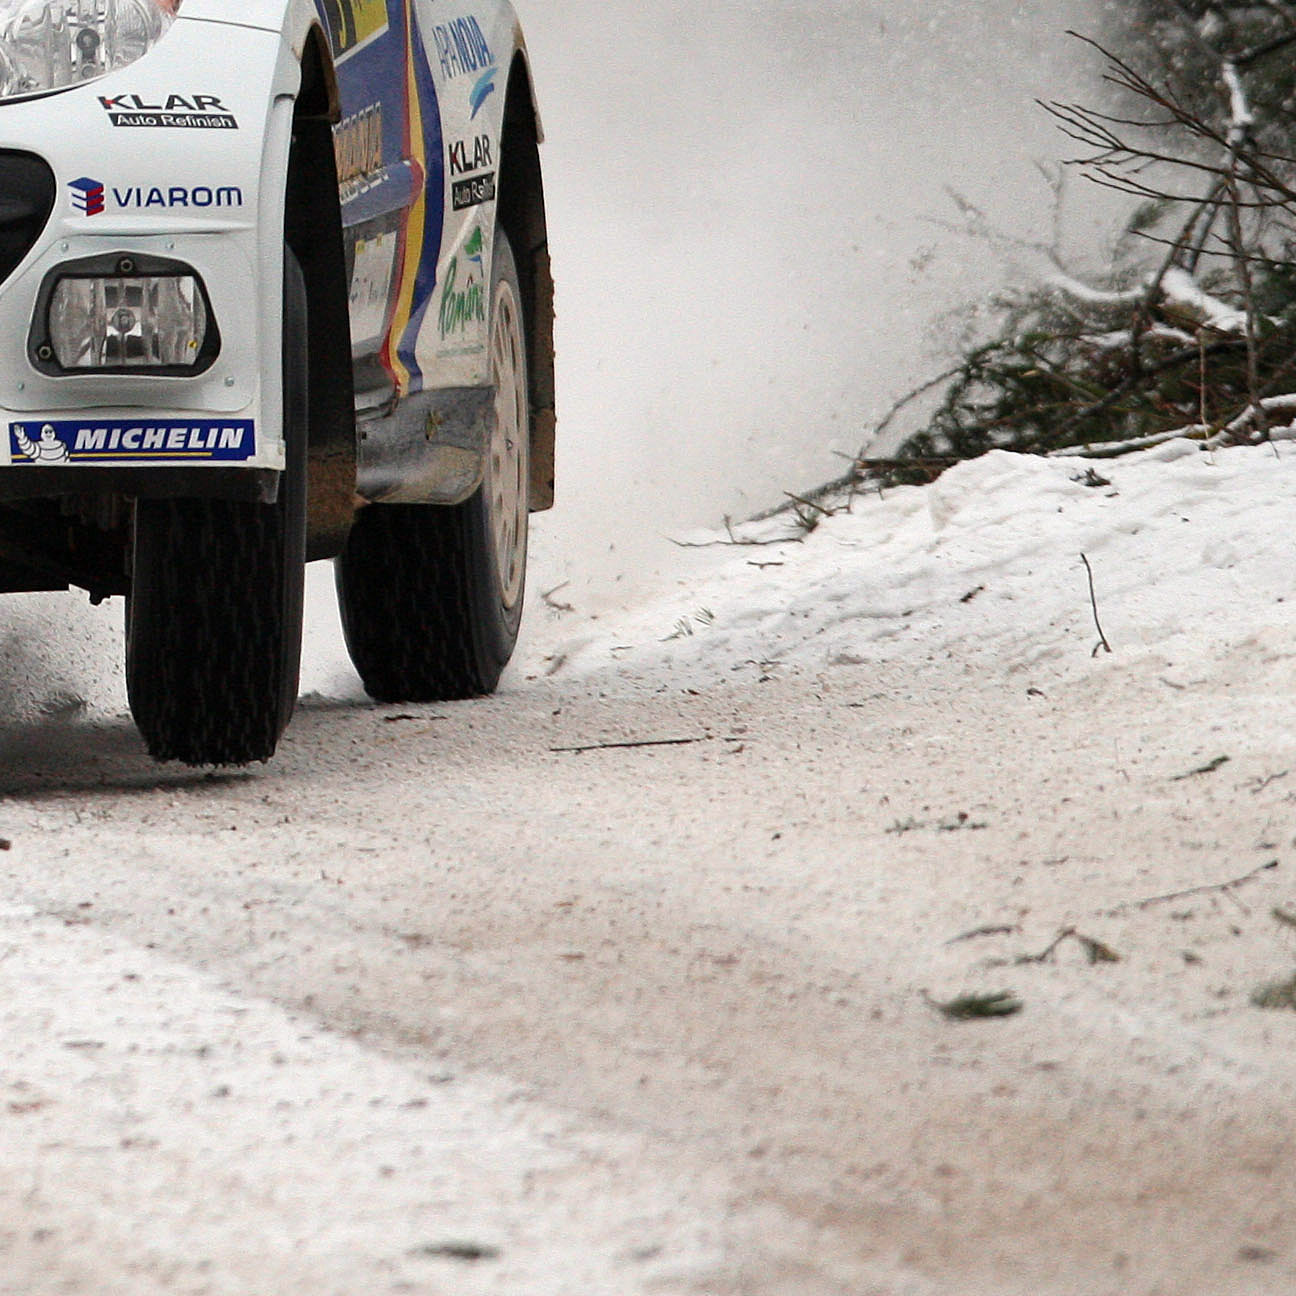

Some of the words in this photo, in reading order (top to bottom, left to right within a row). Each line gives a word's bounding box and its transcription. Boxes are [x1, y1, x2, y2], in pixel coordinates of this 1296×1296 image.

[97, 93, 231, 112] KLAR
[117, 114, 159, 126] Auto
[161, 114, 234, 128] Refinish
[448, 134, 492, 176] KLAR
[112, 186, 243, 208] VIAROM
[74, 427, 245, 450] MICHELIN
